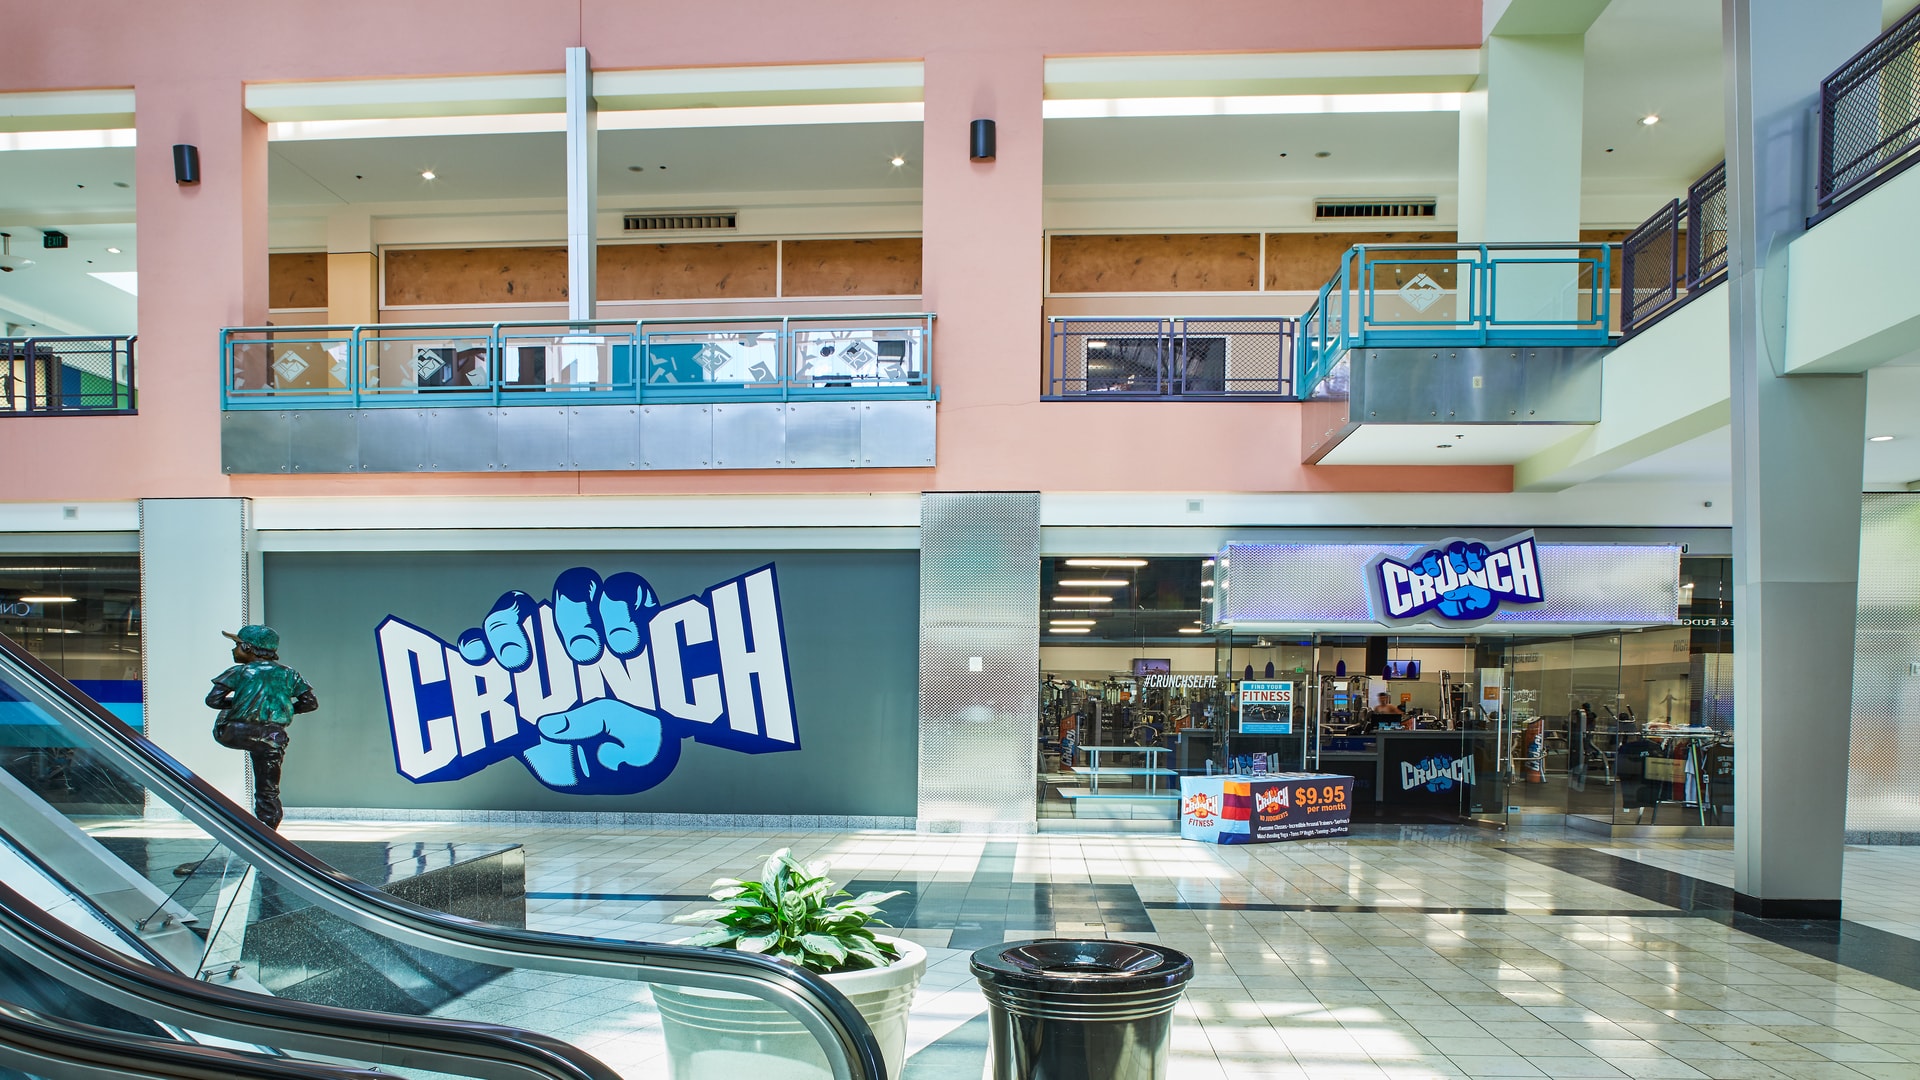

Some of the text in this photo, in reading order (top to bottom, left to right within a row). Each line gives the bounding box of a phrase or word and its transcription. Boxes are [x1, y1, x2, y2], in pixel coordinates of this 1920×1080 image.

[47, 235, 63, 247] EXIT
[1380, 539, 1542, 617] CRUNCH
[377, 563, 799, 782] CRUNCH
[1143, 674, 1219, 689] #CRUNCHSELFIE
[1242, 691, 1291, 701] FITNESS
[1400, 753, 1477, 791] CRUNCH
[1183, 794, 1219, 816] CRUNCH
[1255, 786, 1290, 813] CRUNCH
[1294, 785, 1345, 808] $9.95
[1307, 802, 1347, 814] per month
[1188, 818, 1214, 828] FITNESS
